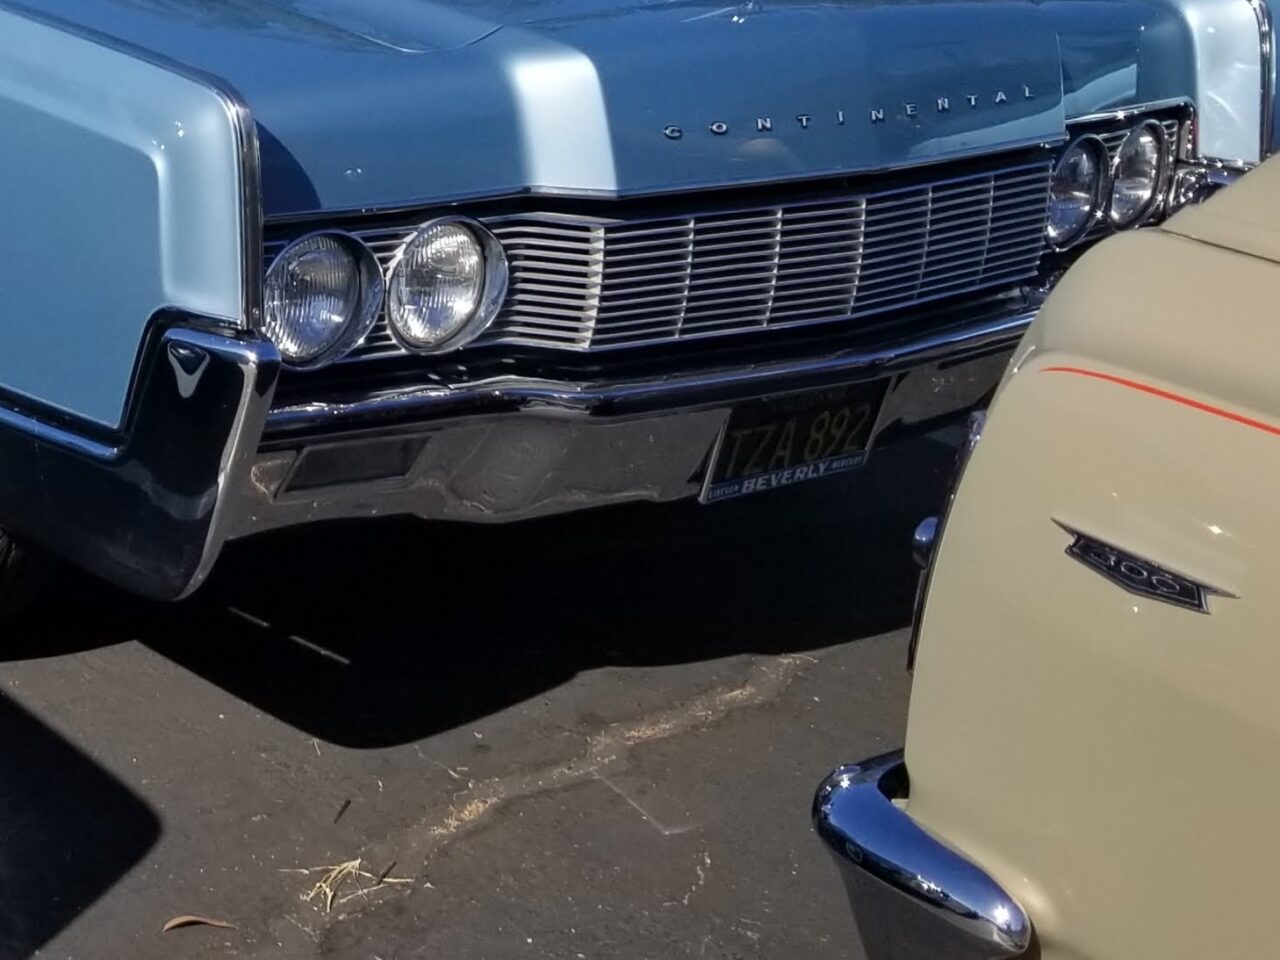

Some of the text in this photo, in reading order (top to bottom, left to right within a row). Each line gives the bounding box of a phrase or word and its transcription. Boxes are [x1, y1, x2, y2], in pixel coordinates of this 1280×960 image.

[663, 85, 1034, 139] CONTINENTAL
[725, 403, 871, 478] TZA 892
[741, 459, 830, 494] BEVERLY
